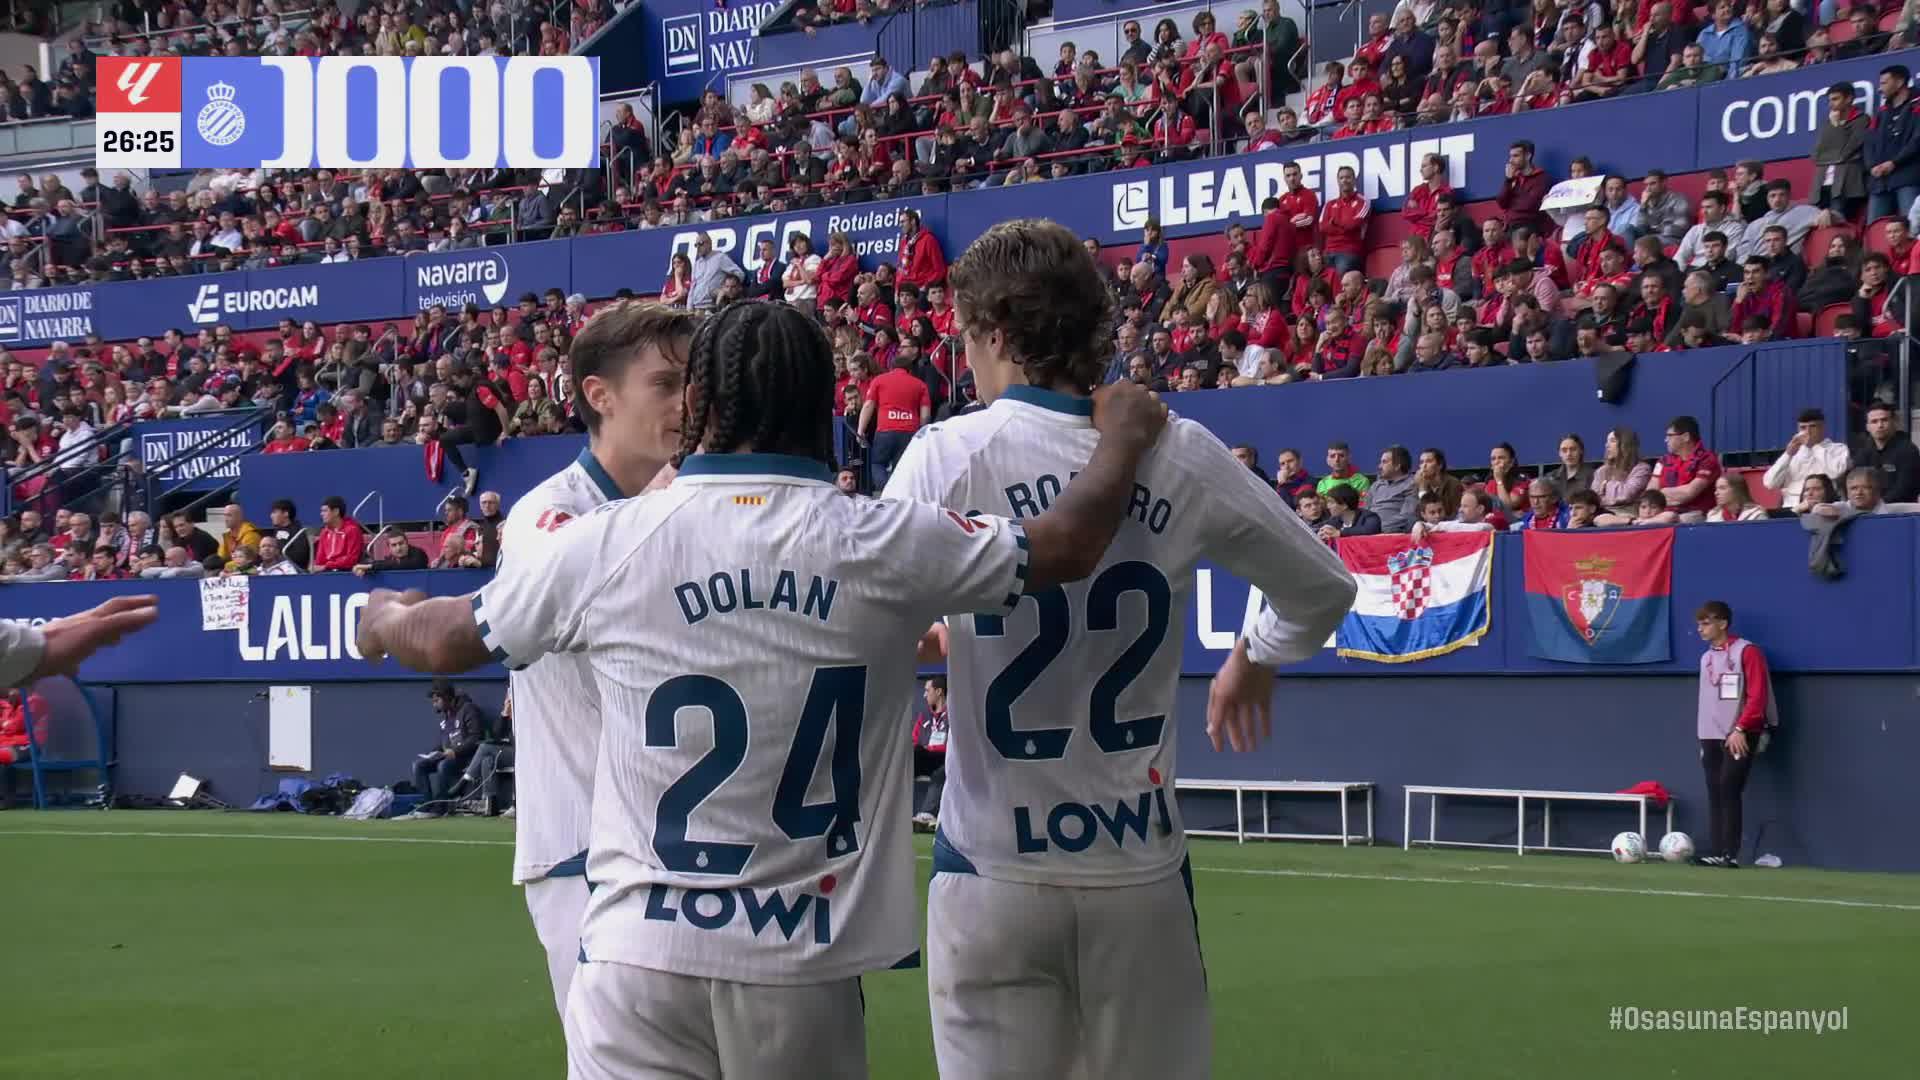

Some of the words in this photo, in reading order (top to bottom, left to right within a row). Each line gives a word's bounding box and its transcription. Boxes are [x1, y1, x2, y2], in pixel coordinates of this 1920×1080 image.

[668, 24, 696, 53] DN
[417, 259, 497, 287] Navarra
[24, 292, 71, 314] DIARIO
[72, 291, 92, 311] DE
[223, 285, 319, 313] EUROCAM
[24, 316, 93, 340] NAVARRA
[145, 441, 169, 462] DN
[1005, 472, 1172, 535] RORO
[673, 567, 840, 626] DOLAN
[974, 560, 1172, 761] 22
[644, 665, 868, 877] 24
